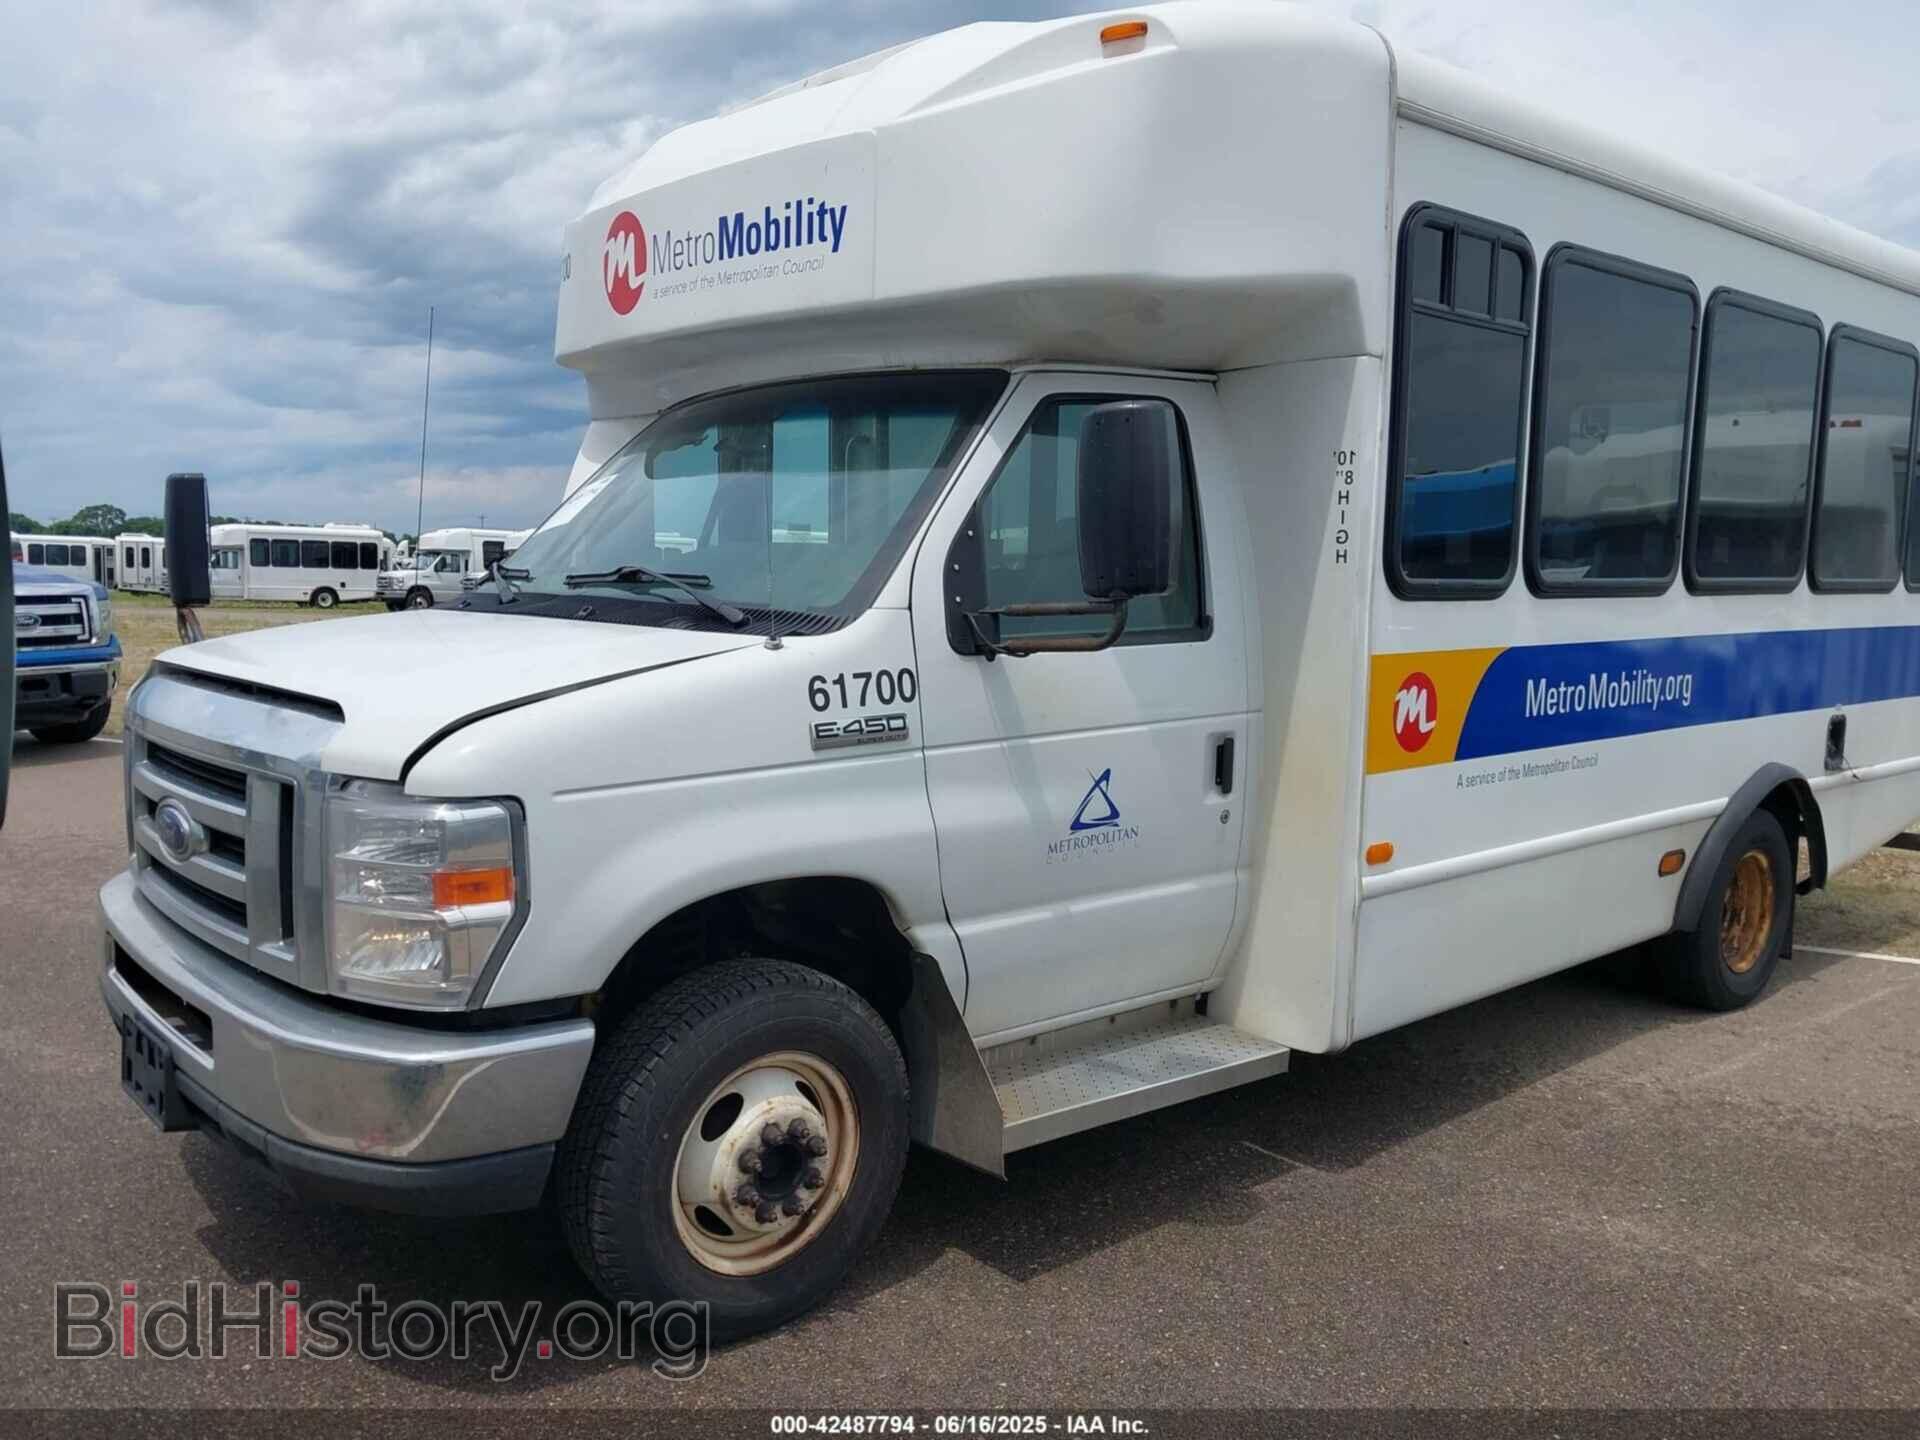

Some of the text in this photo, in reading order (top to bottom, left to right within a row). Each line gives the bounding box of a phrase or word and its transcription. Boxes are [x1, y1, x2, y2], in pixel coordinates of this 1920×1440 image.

[653, 197, 848, 276] MetroMobility
[660, 280, 688, 298] service
[689, 277, 700, 292] of
[700, 273, 714, 290] the
[717, 263, 780, 287] Metropolitan
[783, 255, 825, 275] Council
[808, 667, 917, 712] 61700
[1524, 669, 1693, 718] MetroMobility.org
[814, 715, 907, 739] E-450
[1456, 752, 1599, 789] A service of the Metropolitan Council
[1047, 825, 1139, 855] METROPOLITAN
